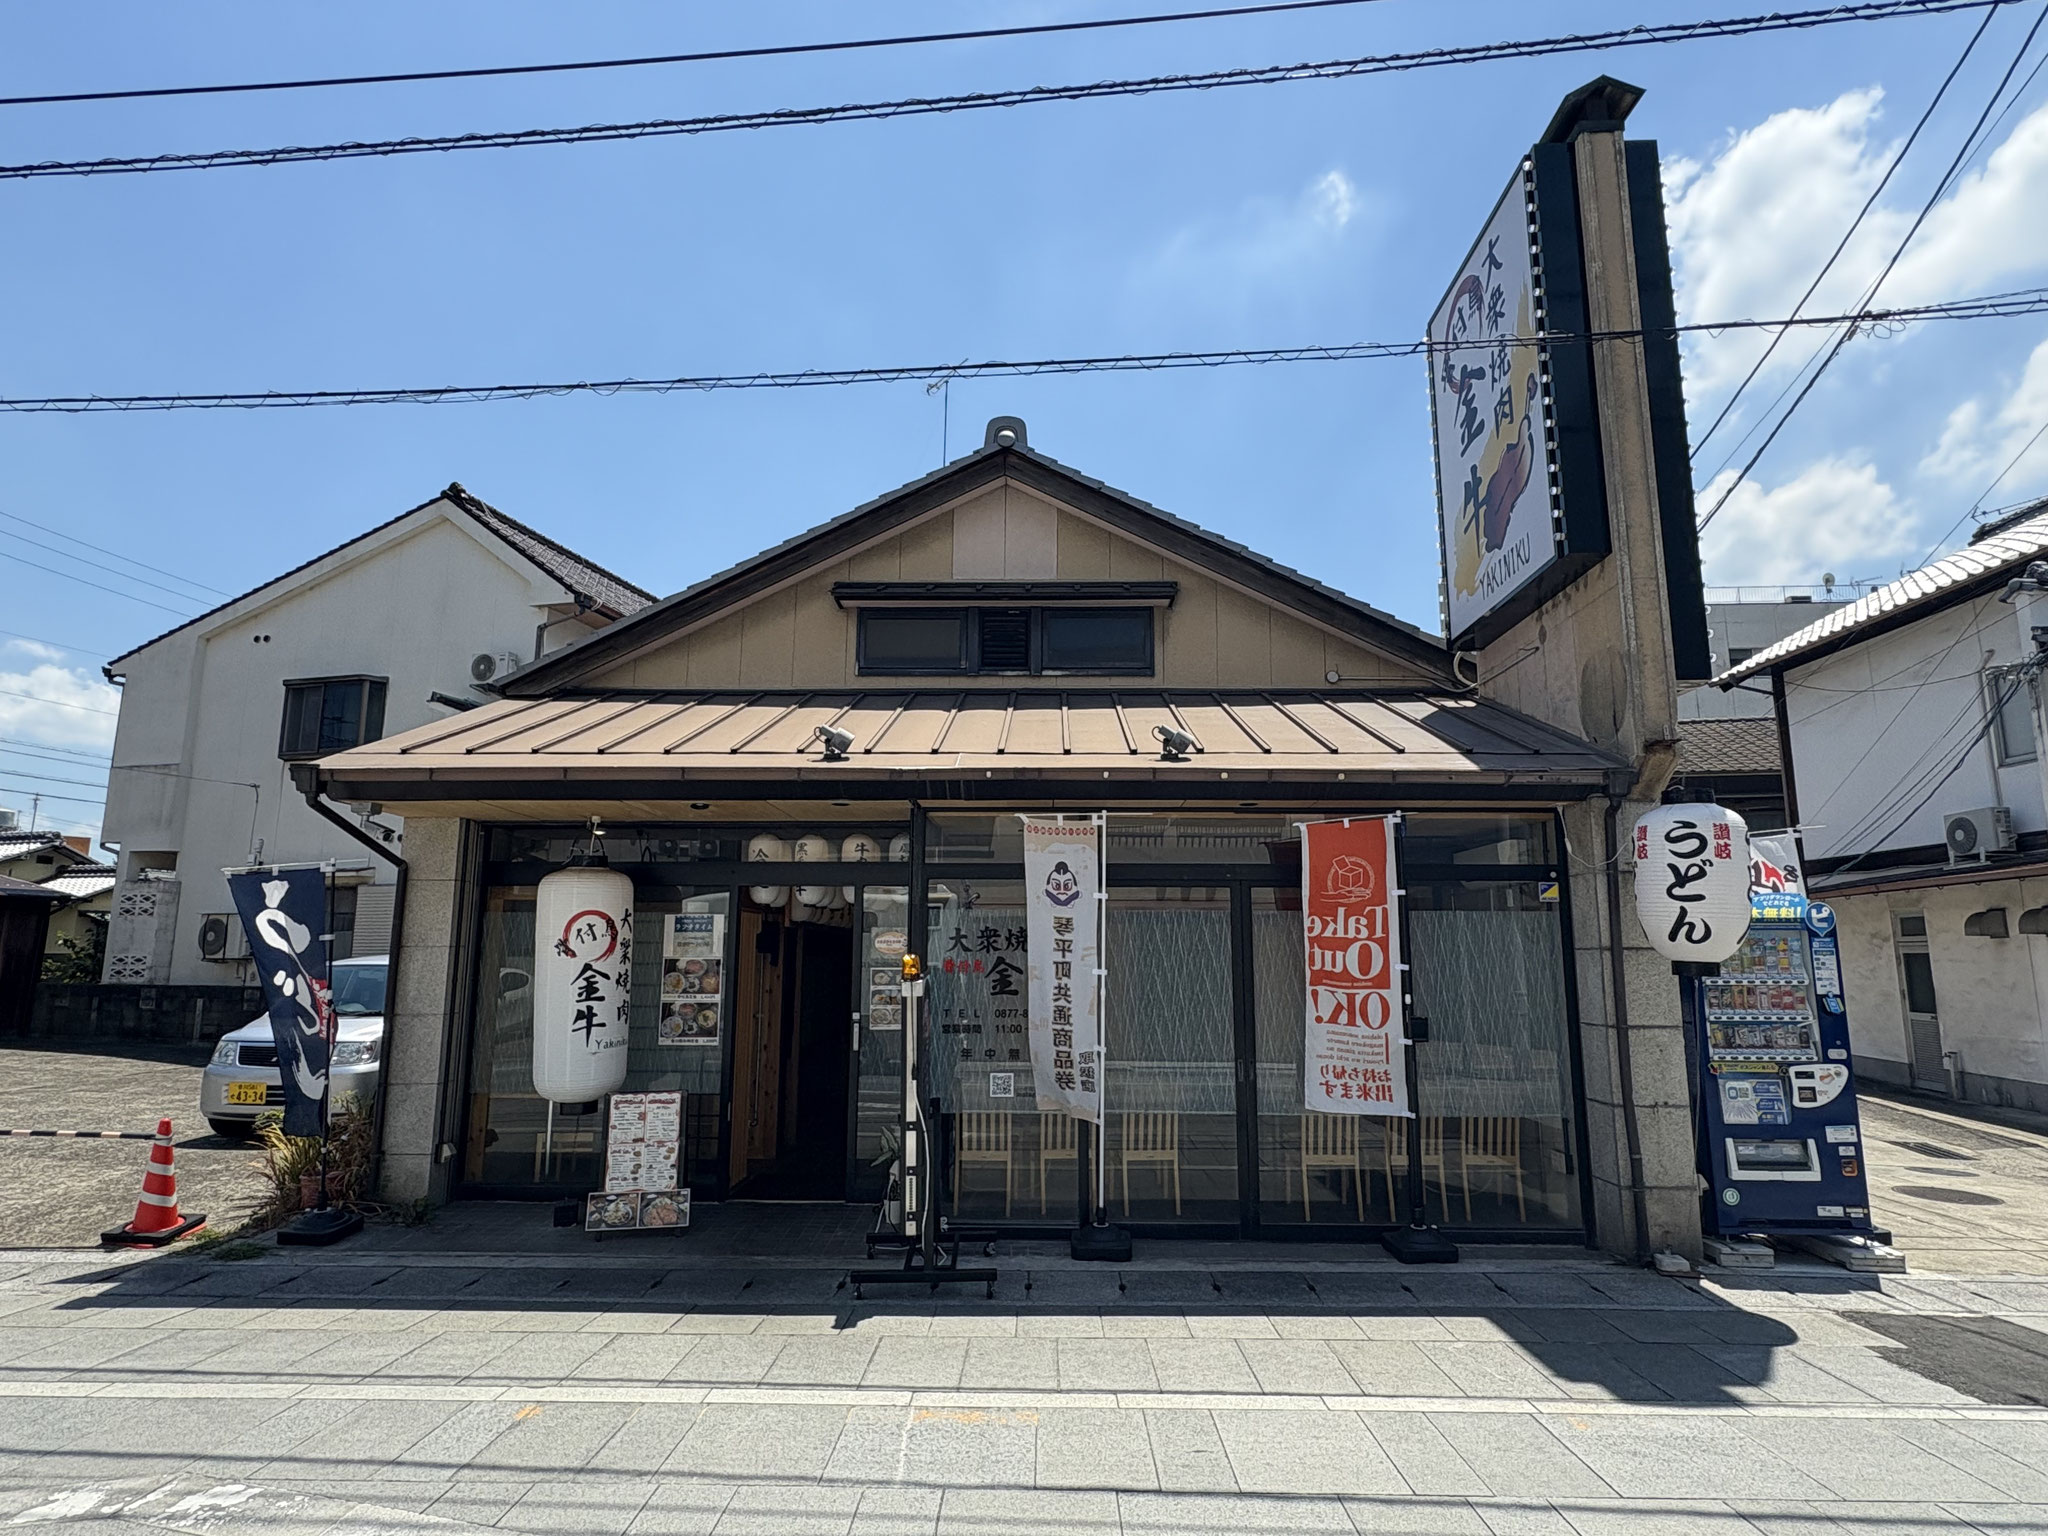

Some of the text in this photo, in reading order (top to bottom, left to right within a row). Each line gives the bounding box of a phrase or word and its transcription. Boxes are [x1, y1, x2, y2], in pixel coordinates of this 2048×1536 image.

[1481, 234, 1514, 439] 大衆焼肉
[1454, 364, 1487, 557] 金牛
[1479, 532, 1531, 600] YAKINIKU
[1664, 820, 1714, 945] うどん
[1811, 907, 1831, 928] ピ
[570, 962, 611, 1048] 金牛
[615, 908, 632, 1025] 大衆焼肉
[984, 956, 1024, 996] 金
[942, 1024, 982, 1034] 営業時間
